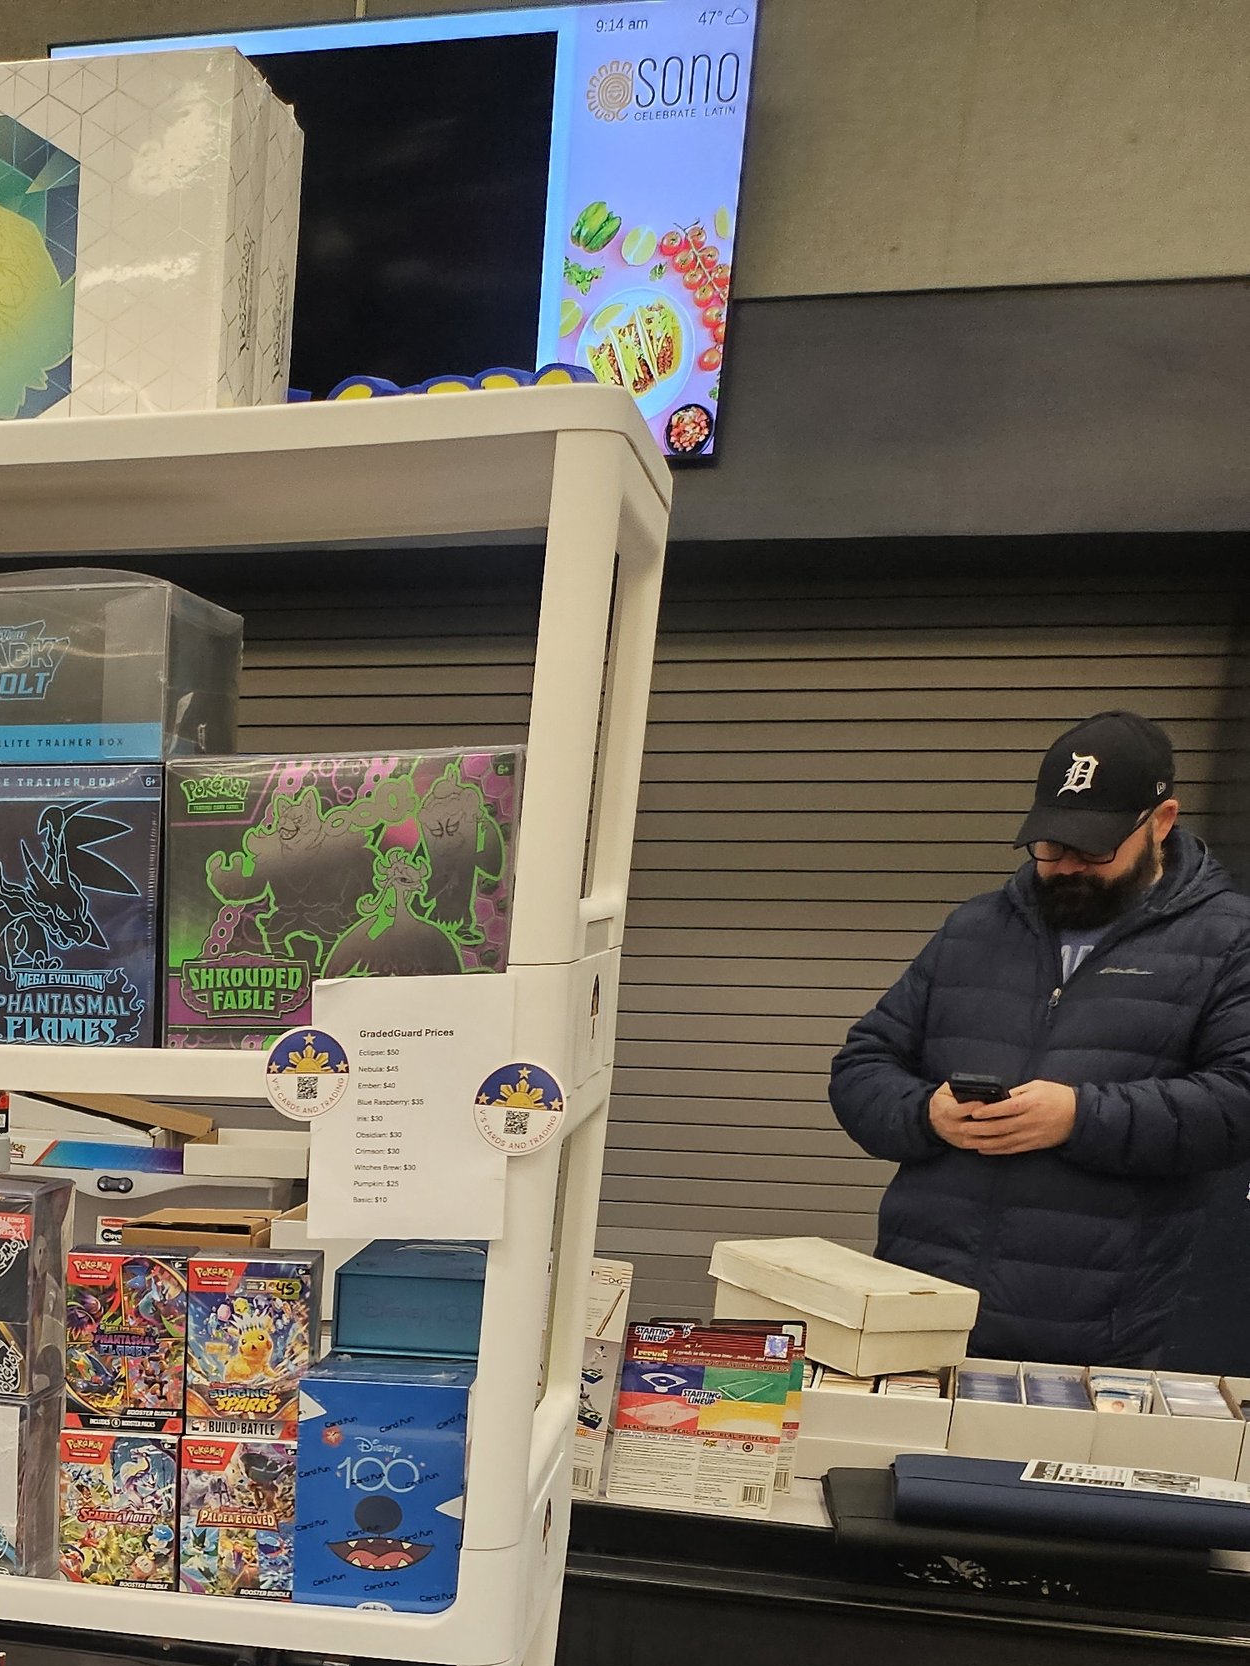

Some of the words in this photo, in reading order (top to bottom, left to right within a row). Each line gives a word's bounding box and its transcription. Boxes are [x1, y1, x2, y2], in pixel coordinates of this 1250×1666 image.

[596, 18, 625, 33] 9:14
[628, 17, 648, 31] am
[634, 107, 696, 121] CELEBRATE
[705, 106, 736, 118] LATIN
[38, 738, 92, 748] TRAINER
[99, 737, 123, 747] BOX
[17, 778, 81, 787] TRAINER
[88, 777, 116, 787] BOX
[145, 776, 156, 787] 6+
[18, 973, 46, 988] MEGA
[48, 973, 103, 988] EVOLUTION
[189, 968, 302, 991] SHROUDED
[212, 990, 276, 1011] FABLE
[5, 1016, 118, 1045] FLAMES
[360, 1029, 422, 1038] GradedGuard
[425, 1029, 454, 1037] Prices
[277, 1092, 301, 1112] CARDS
[303, 1106, 319, 1114] AND
[320, 1077, 344, 1109] TRADING
[483, 1125, 507, 1147] CARDS
[529, 1115, 557, 1146] TRADING
[636, 1326, 675, 1337] STARTING
[640, 1334, 669, 1342] LINEUP
[94, 1333, 156, 1346] PHANTASMAL
[209, 1388, 269, 1399] SURGING
[682, 1389, 722, 1400] STARTING
[216, 1397, 281, 1413] SPARKS
[687, 1397, 716, 1405] LINEUP
[209, 1421, 235, 1433] BUILD
[240, 1422, 276, 1435] BATTLE
[354, 1436, 403, 1458] Disney
[337, 1456, 420, 1493] 100
[200, 1510, 233, 1524] PALDEA
[235, 1512, 275, 1526] EVOLVED
[119, 1581, 145, 1590] BOOSTER
[145, 1582, 168, 1591] BUNDLE
[240, 1589, 266, 1597] BOOSTER
[267, 1590, 291, 1598] BUNDLE
